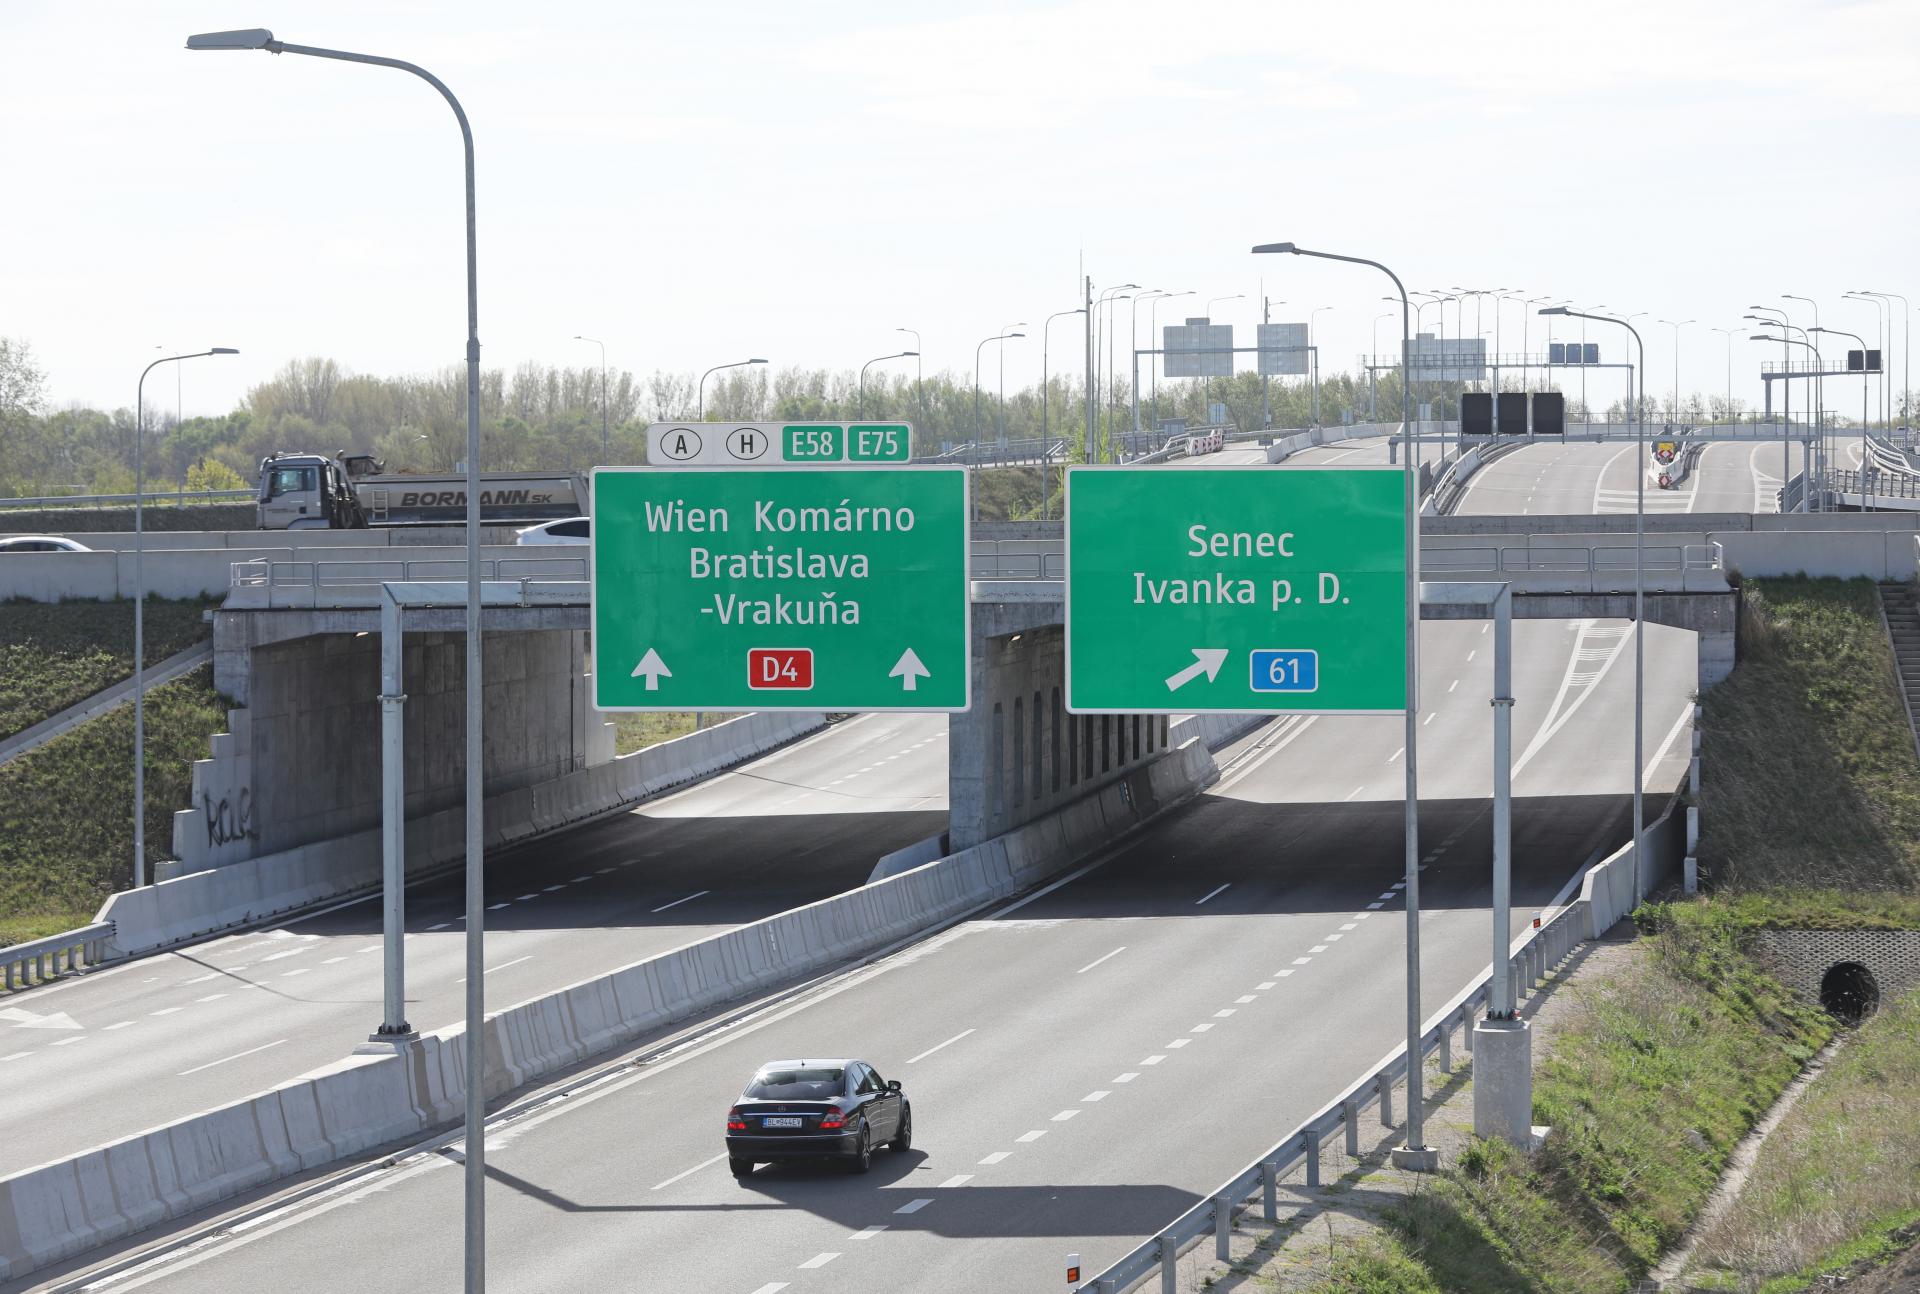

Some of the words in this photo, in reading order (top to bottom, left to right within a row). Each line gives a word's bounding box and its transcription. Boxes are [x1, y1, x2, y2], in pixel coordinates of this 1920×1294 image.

[674, 434, 688, 454] A
[740, 434, 753, 454] H
[793, 432, 833, 455] E58
[859, 432, 897, 455] E75
[645, 500, 727, 532] Wien
[756, 499, 914, 531] Komárno
[1189, 525, 1293, 556] Senec
[691, 546, 868, 578] Bratislava
[1134, 573, 1255, 603] Ivanka
[1273, 580, 1301, 611] p.
[1319, 573, 1349, 604] D.
[701, 592, 859, 624] -Vrakuňa
[763, 657, 798, 682] D4
[1270, 658, 1298, 683] 61
